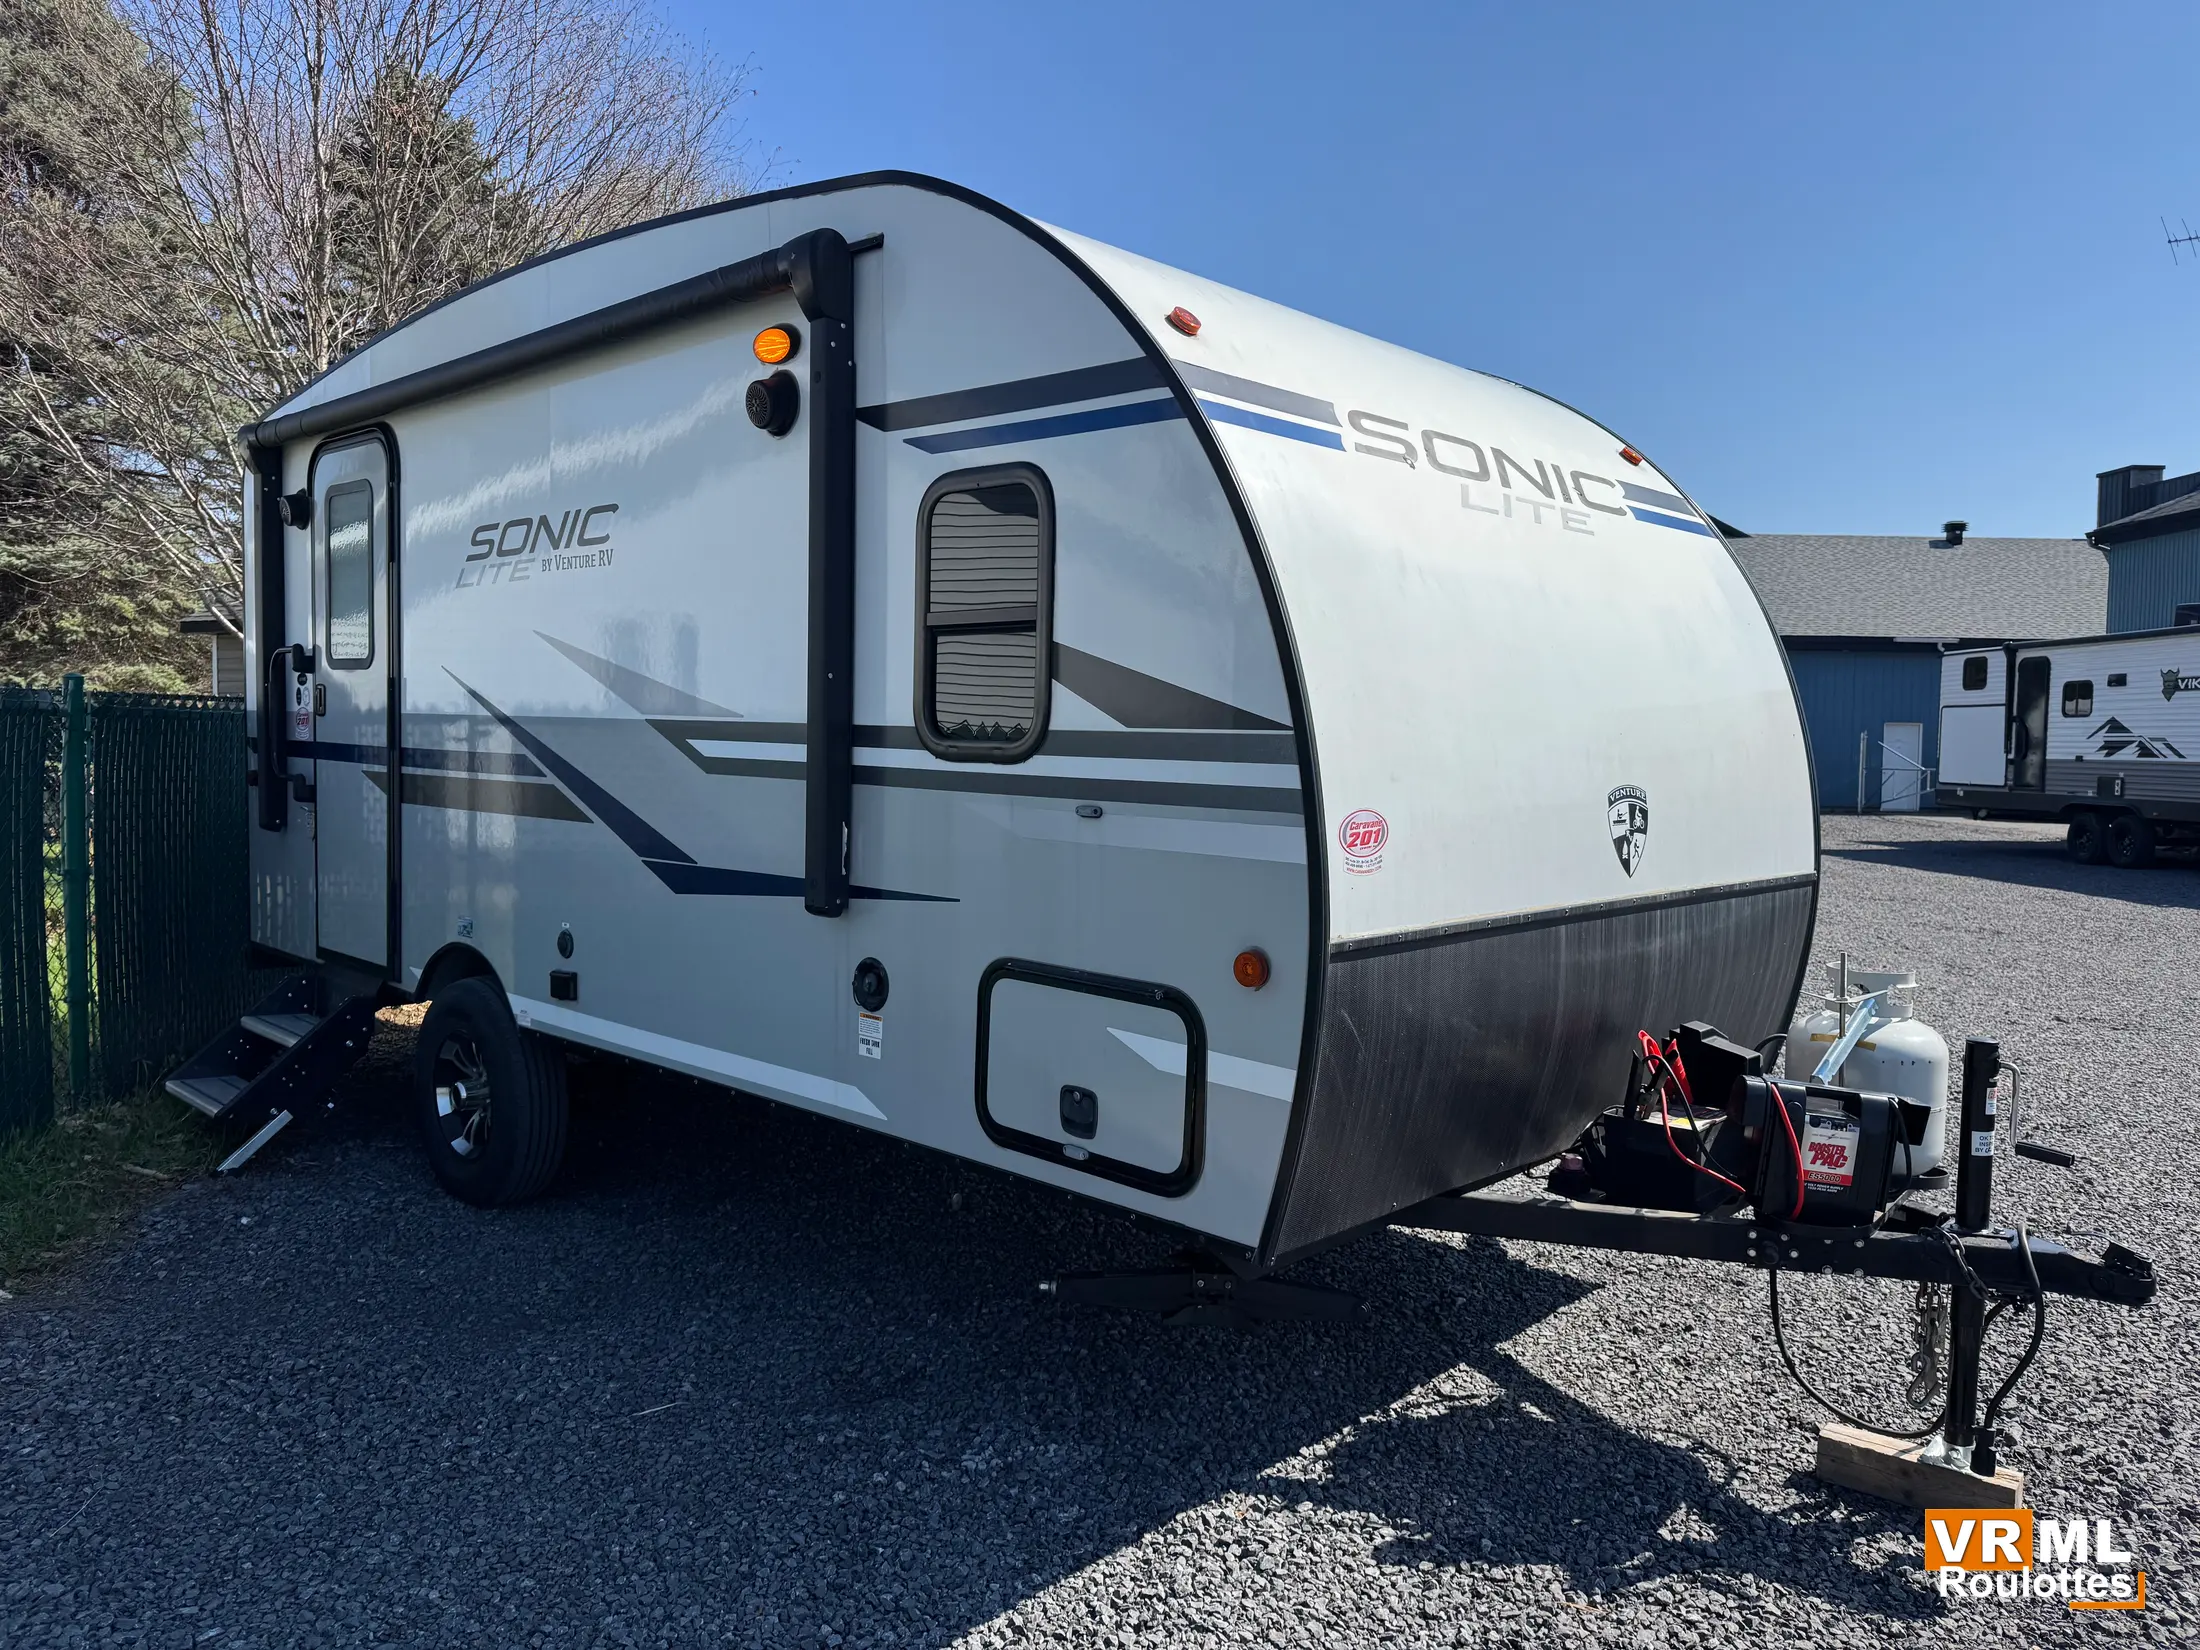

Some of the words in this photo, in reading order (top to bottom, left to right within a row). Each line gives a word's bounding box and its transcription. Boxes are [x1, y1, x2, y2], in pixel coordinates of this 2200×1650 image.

[1347, 409, 1628, 517] SONIC
[1460, 483, 1595, 536] LITE
[465, 503, 620, 562] SONIC
[541, 558, 553, 572] BY
[598, 548, 614, 568] RV
[455, 557, 536, 589] LITE
[1610, 787, 1647, 802] VENTURE
[1346, 828, 1382, 848] 201
[1808, 1142, 1847, 1156] BOOSTER
[1809, 1151, 1849, 1168] PAC
